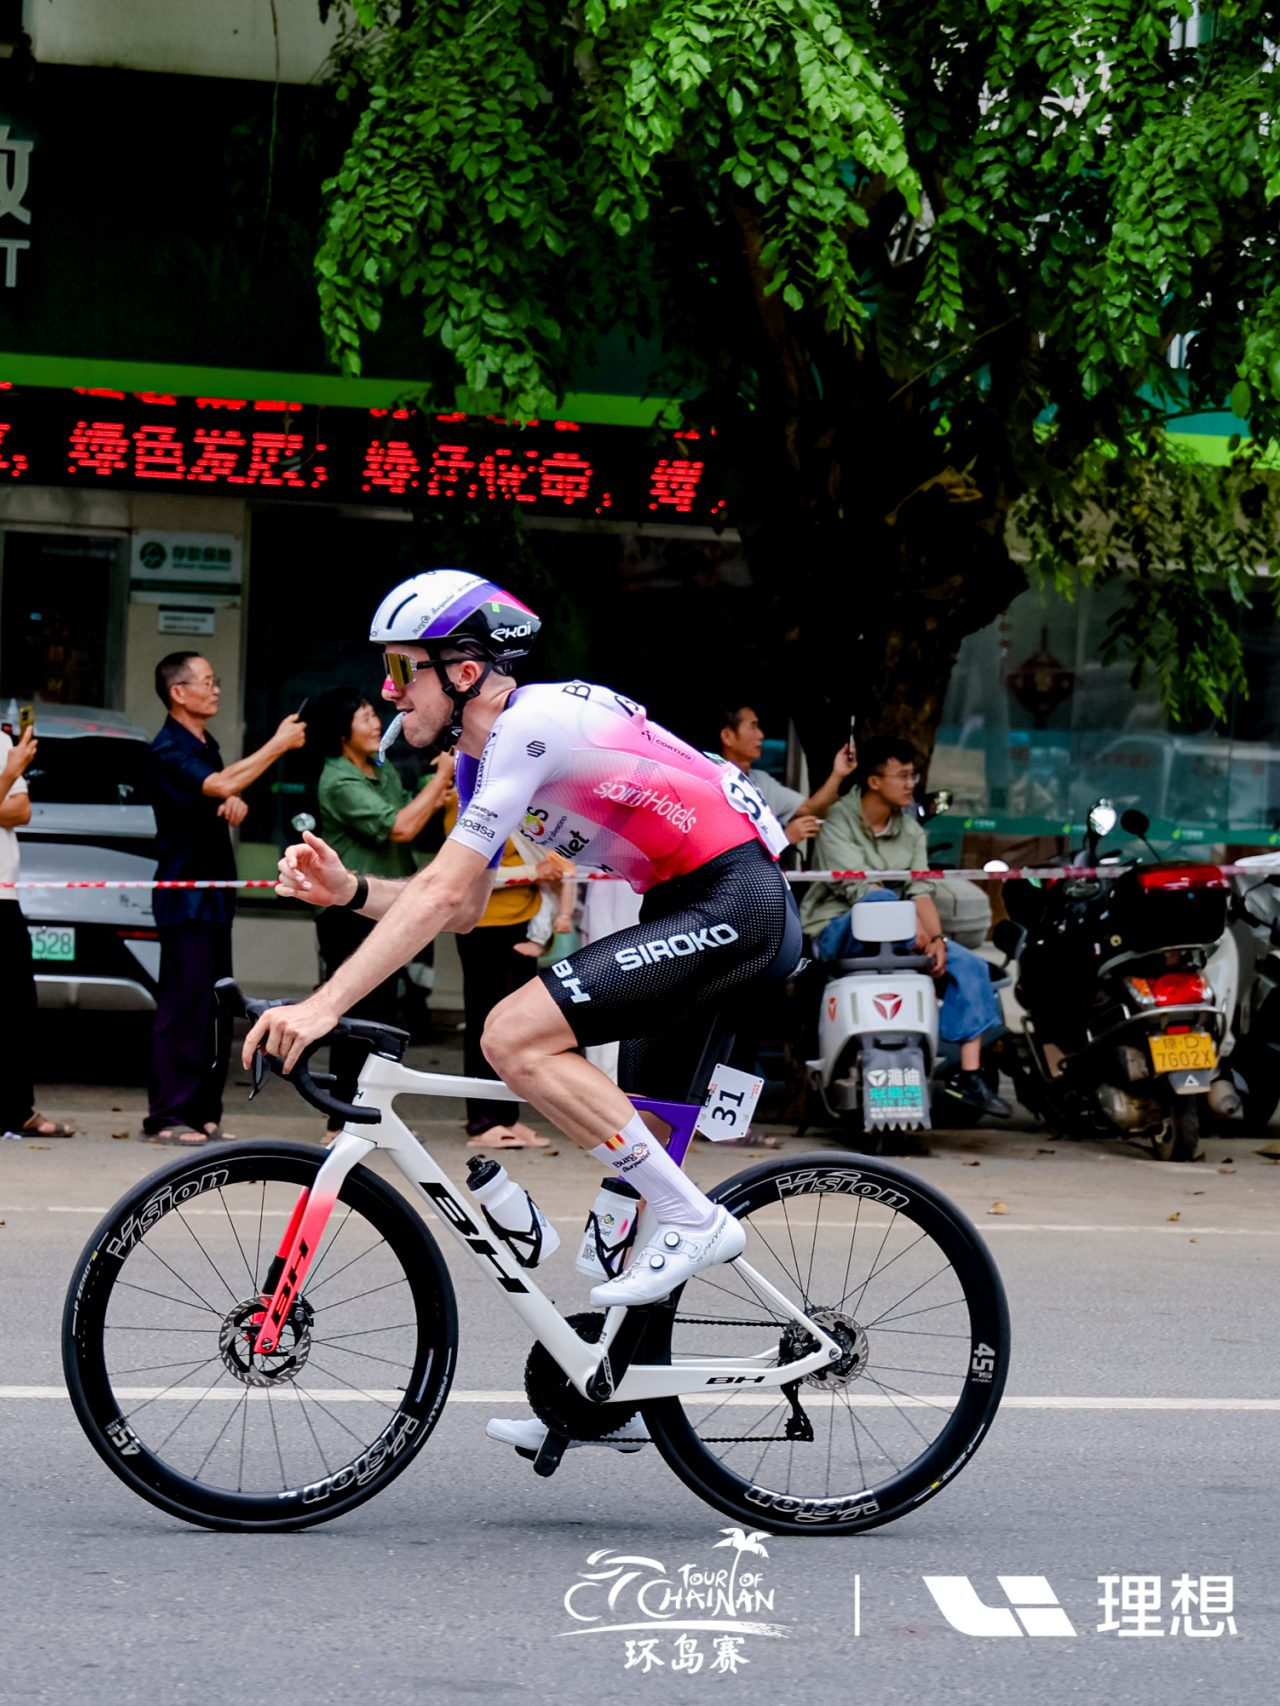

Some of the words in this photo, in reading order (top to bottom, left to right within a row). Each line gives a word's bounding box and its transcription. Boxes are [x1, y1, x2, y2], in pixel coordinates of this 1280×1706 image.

[614, 923, 740, 972] SIROKO
[551, 959, 592, 1004] BH
[711, 1090, 746, 1126] 31
[776, 1170, 910, 1210] Vision
[106, 1169, 230, 1260] Vision
[418, 1181, 531, 1294] BH
[271, 1238, 309, 1327] BH
[972, 1342, 996, 1371] 45
[705, 1376, 766, 1385] BH
[302, 1410, 420, 1504] Vision
[743, 1485, 880, 1523] Vision
